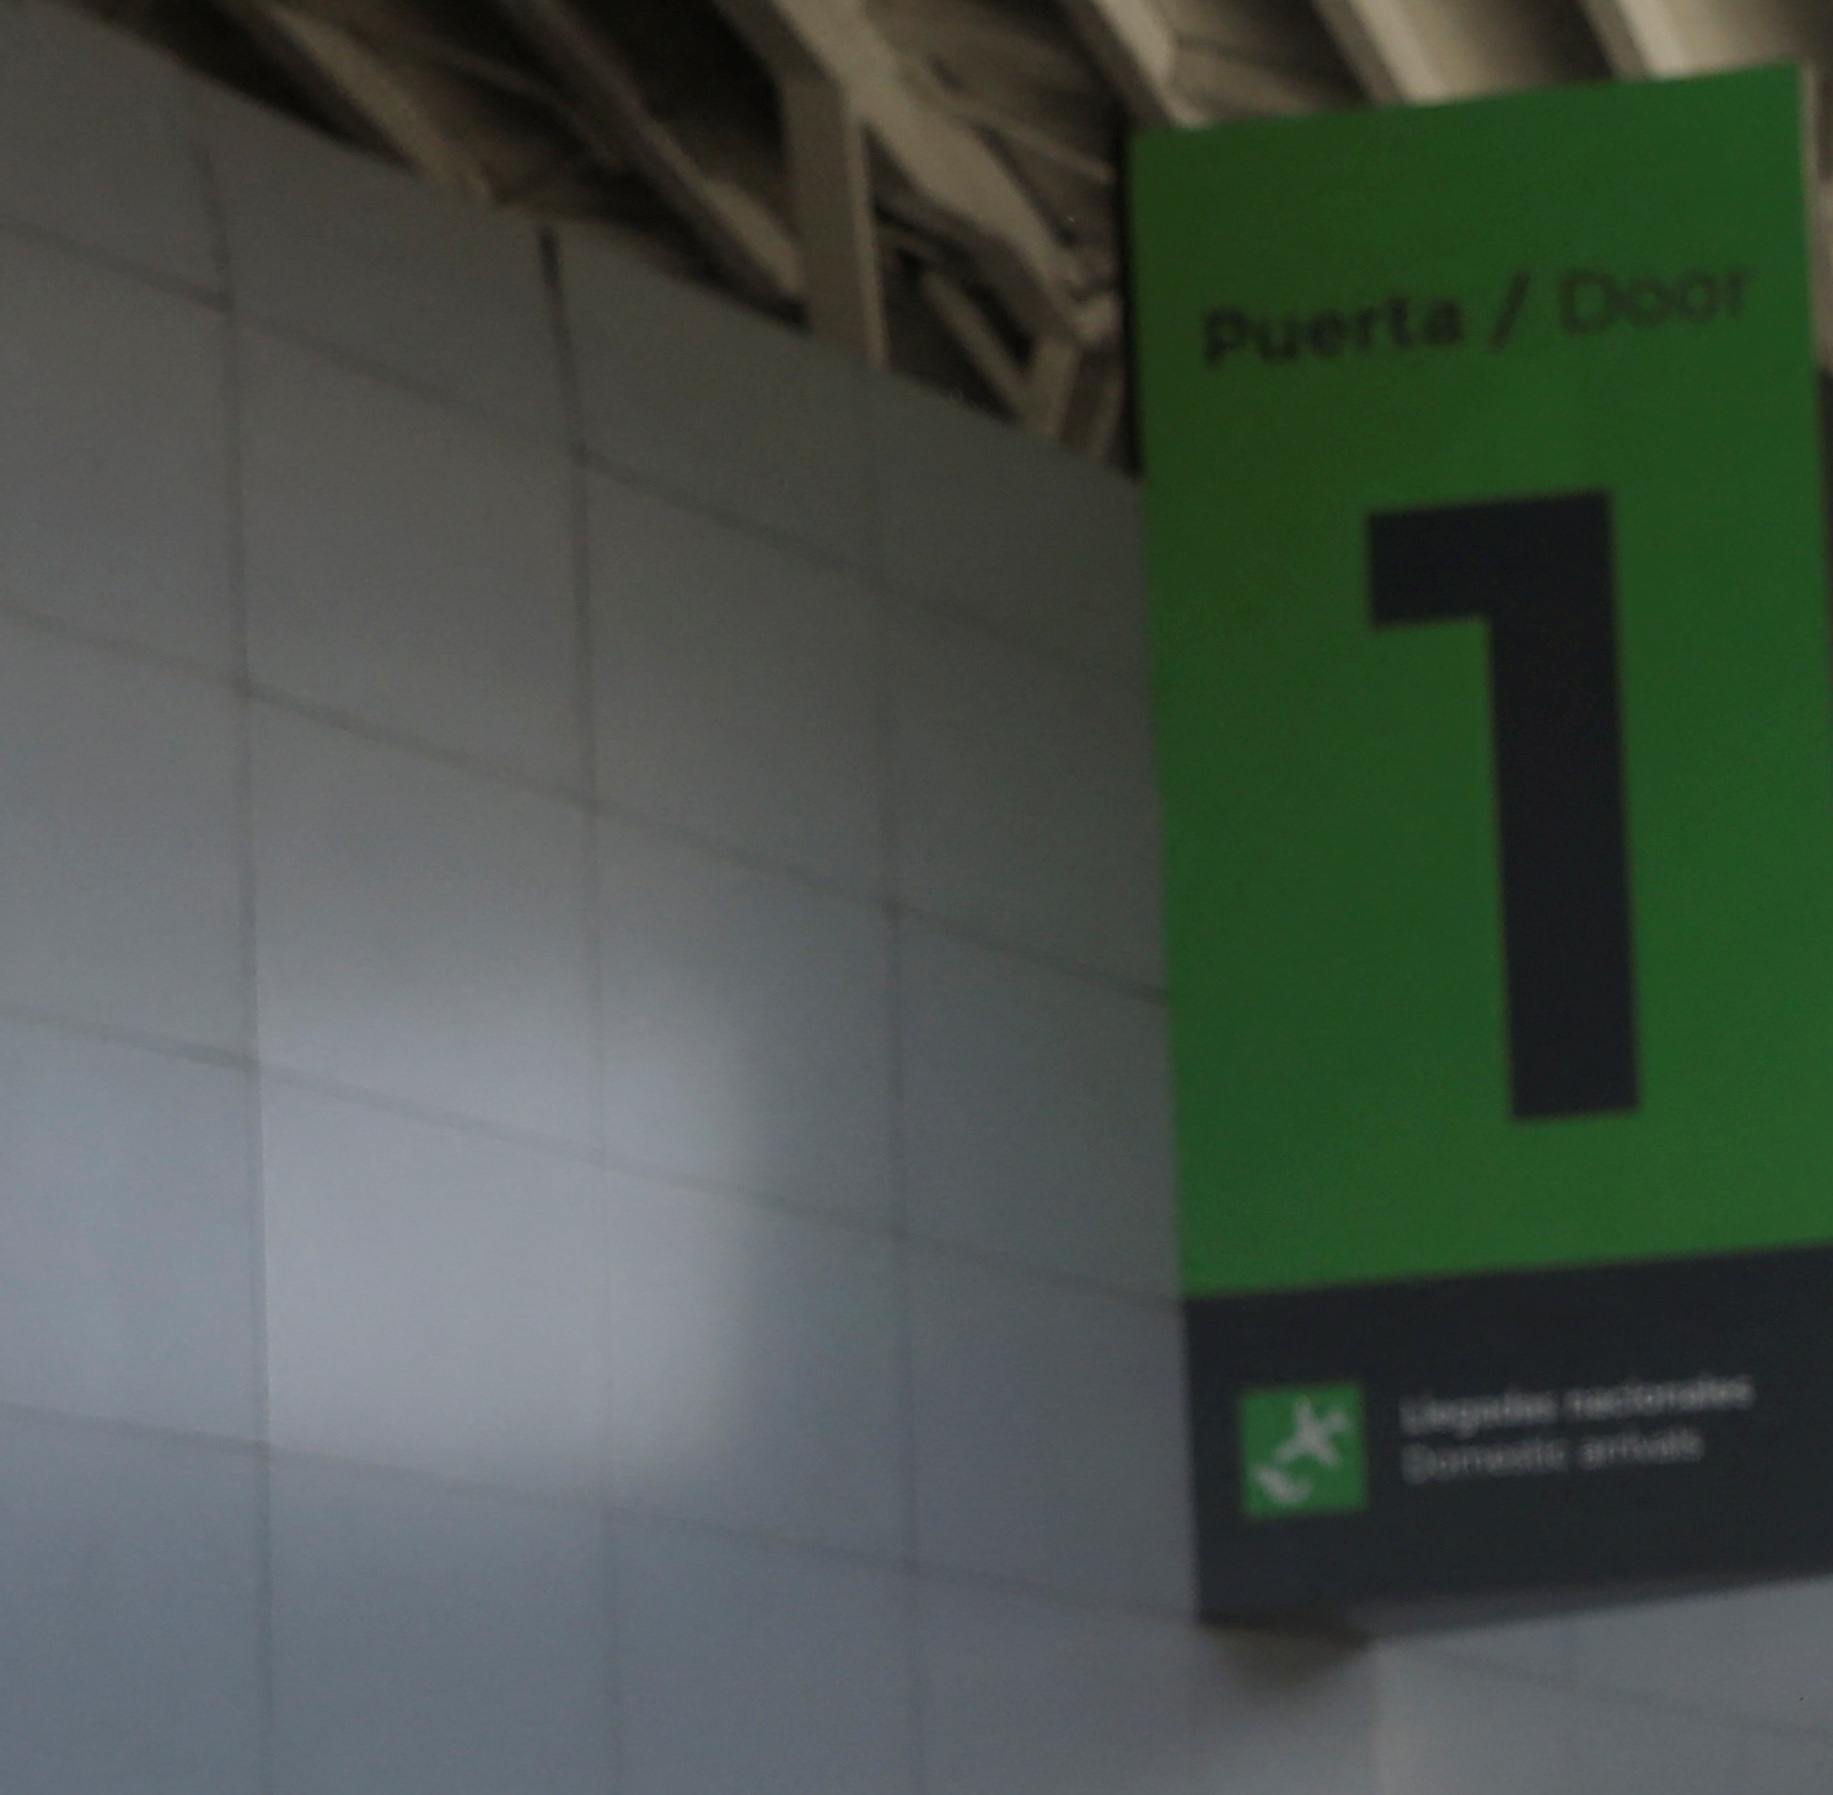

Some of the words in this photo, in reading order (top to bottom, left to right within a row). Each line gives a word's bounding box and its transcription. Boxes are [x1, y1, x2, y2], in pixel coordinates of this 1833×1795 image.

[1203, 296, 1466, 368] Puerta
[1489, 270, 1531, 350] /
[1559, 266, 1752, 334] Door
[1366, 490, 1640, 1122] 1
